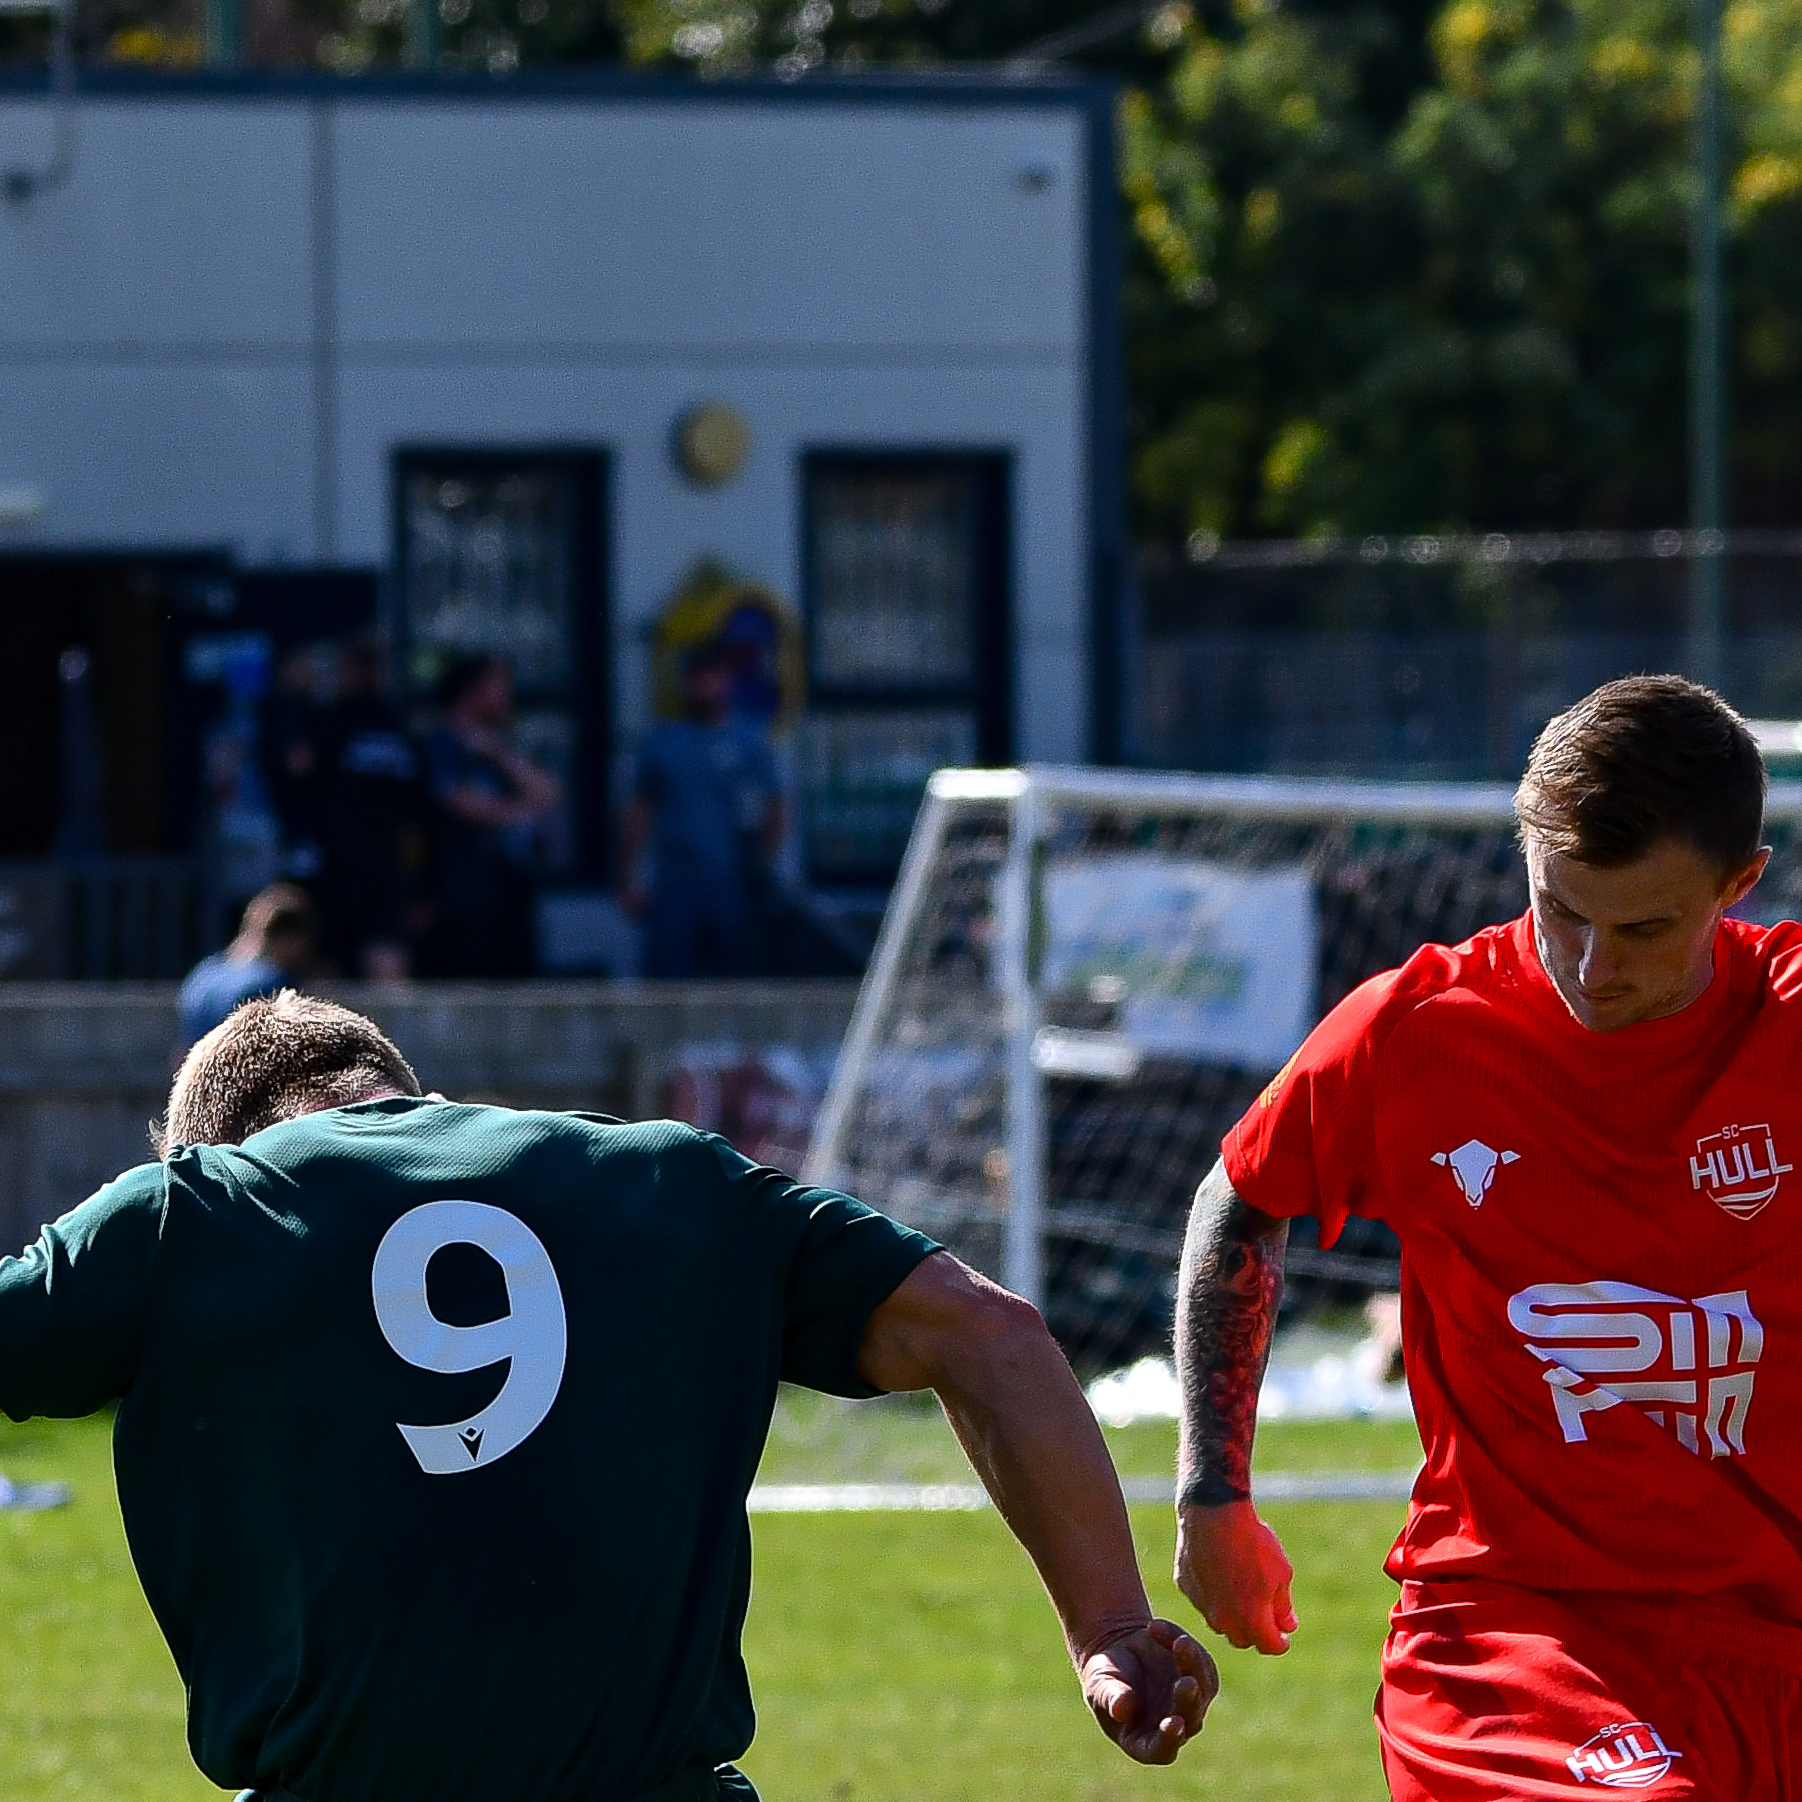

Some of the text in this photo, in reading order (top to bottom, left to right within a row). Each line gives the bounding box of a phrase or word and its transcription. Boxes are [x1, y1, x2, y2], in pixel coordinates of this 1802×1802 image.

[1722, 1124, 1739, 1139] SC
[1690, 1138, 1793, 1189] HULL
[372, 1200, 567, 1474] 9
[1565, 1732, 1683, 1783] HULL
